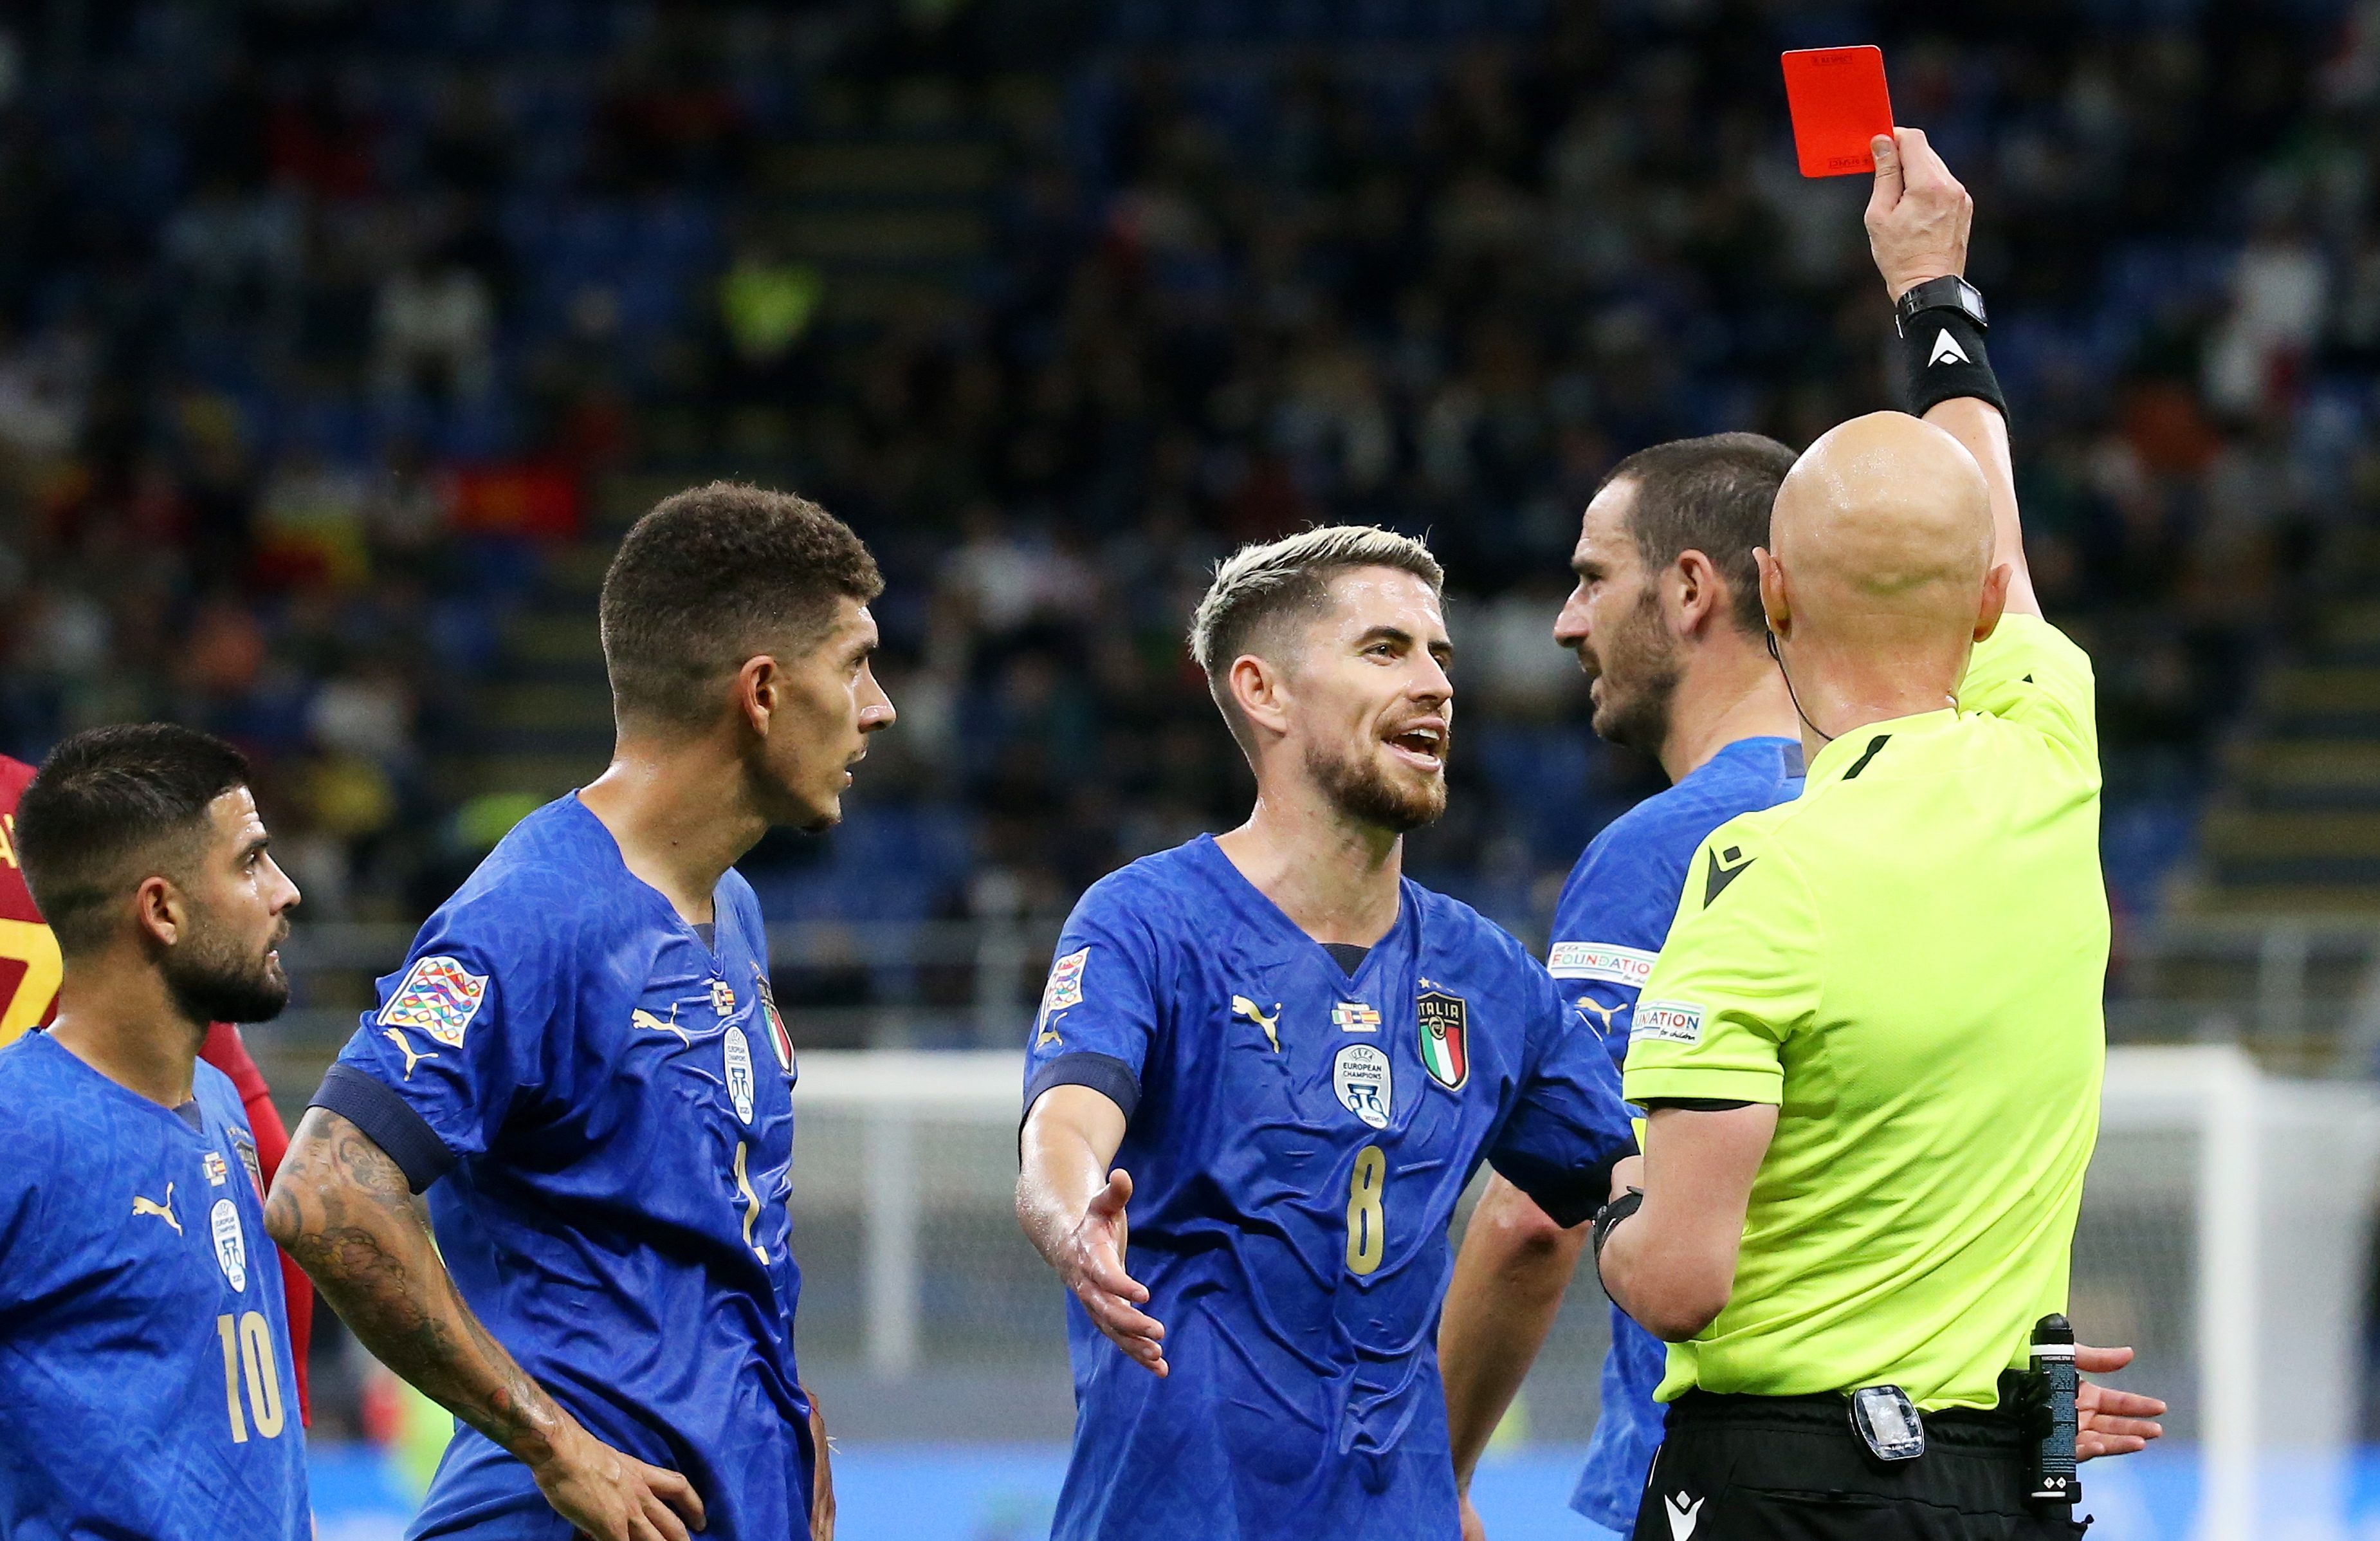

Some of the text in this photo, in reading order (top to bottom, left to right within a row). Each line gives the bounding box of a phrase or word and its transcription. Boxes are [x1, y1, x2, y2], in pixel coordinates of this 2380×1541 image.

[1552, 954, 1651, 974] FOUNDATIO
[1418, 1002, 1459, 1019] ITALIA
[1343, 1062, 1382, 1072] EUROPEAN
[1343, 1071, 1382, 1080] CHAMPIONS
[1346, 1145, 1386, 1275] 8
[217, 1311, 284, 1443] 10
